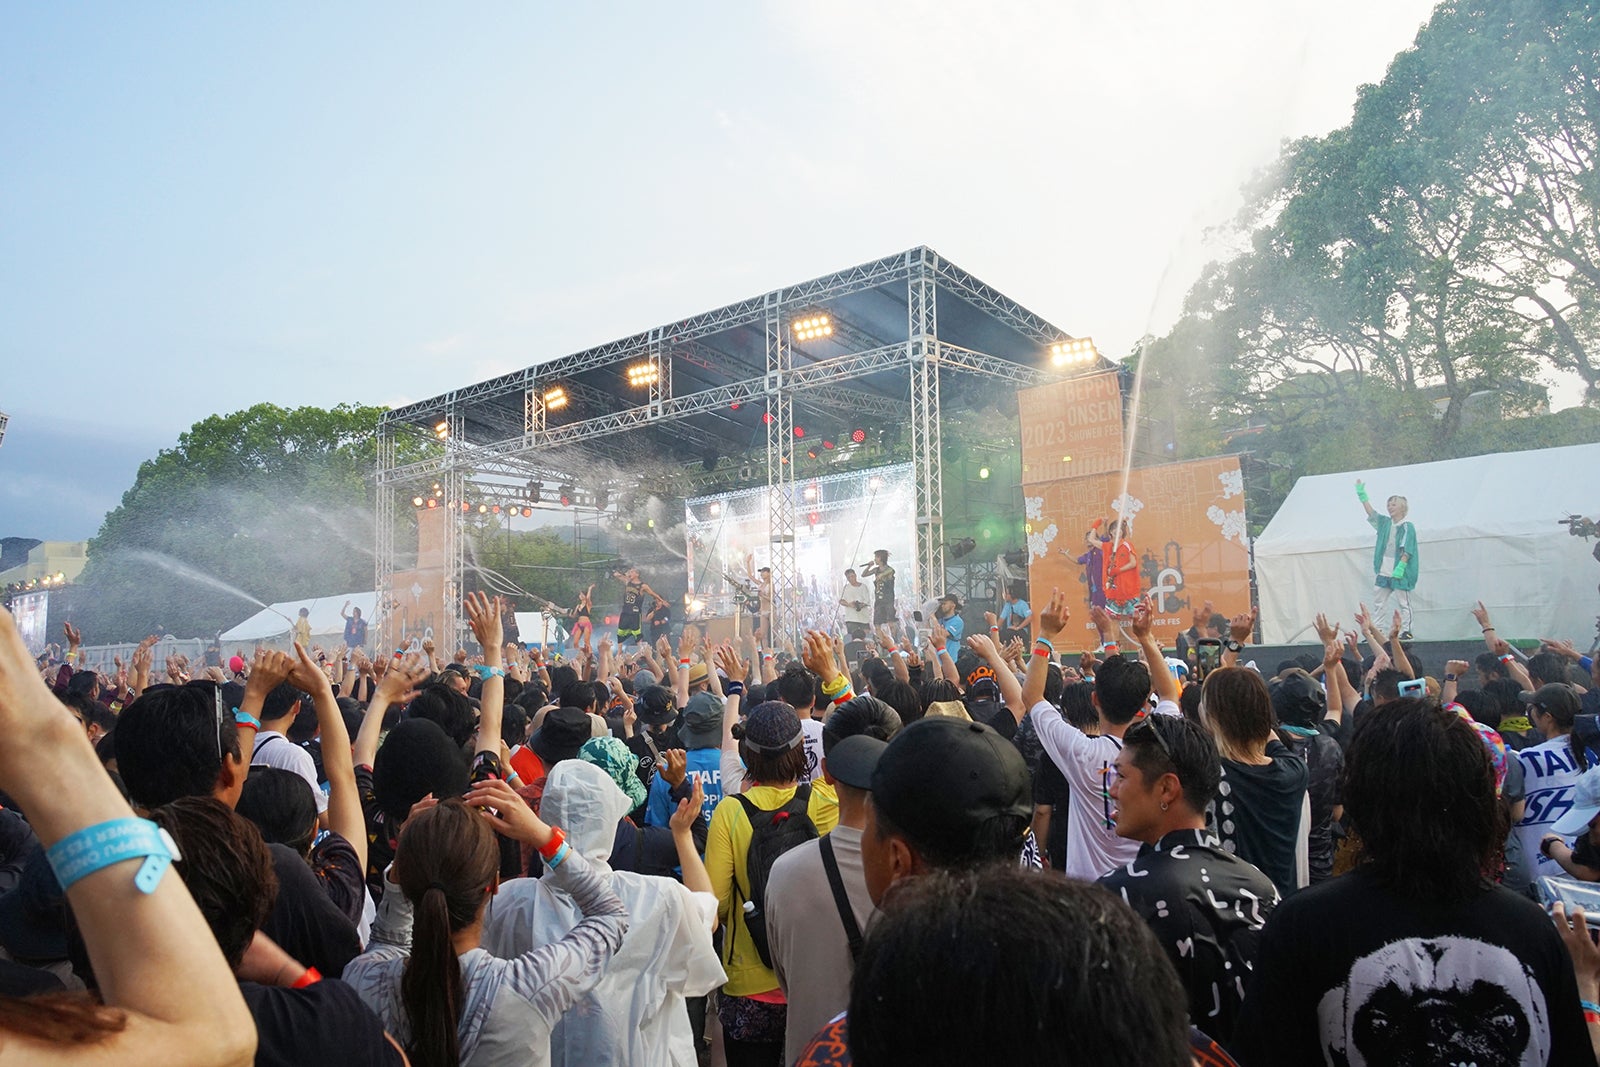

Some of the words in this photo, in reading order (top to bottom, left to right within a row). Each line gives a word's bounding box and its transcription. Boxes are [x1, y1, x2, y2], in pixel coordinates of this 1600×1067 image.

[1065, 376, 1117, 403] BEPPU
[1068, 400, 1119, 426] ONSEN
[1025, 421, 1066, 449] 2023
[1069, 427, 1103, 441] SHOWER
[1104, 424, 1120, 437] FES
[1168, 617, 1181, 625] FES
